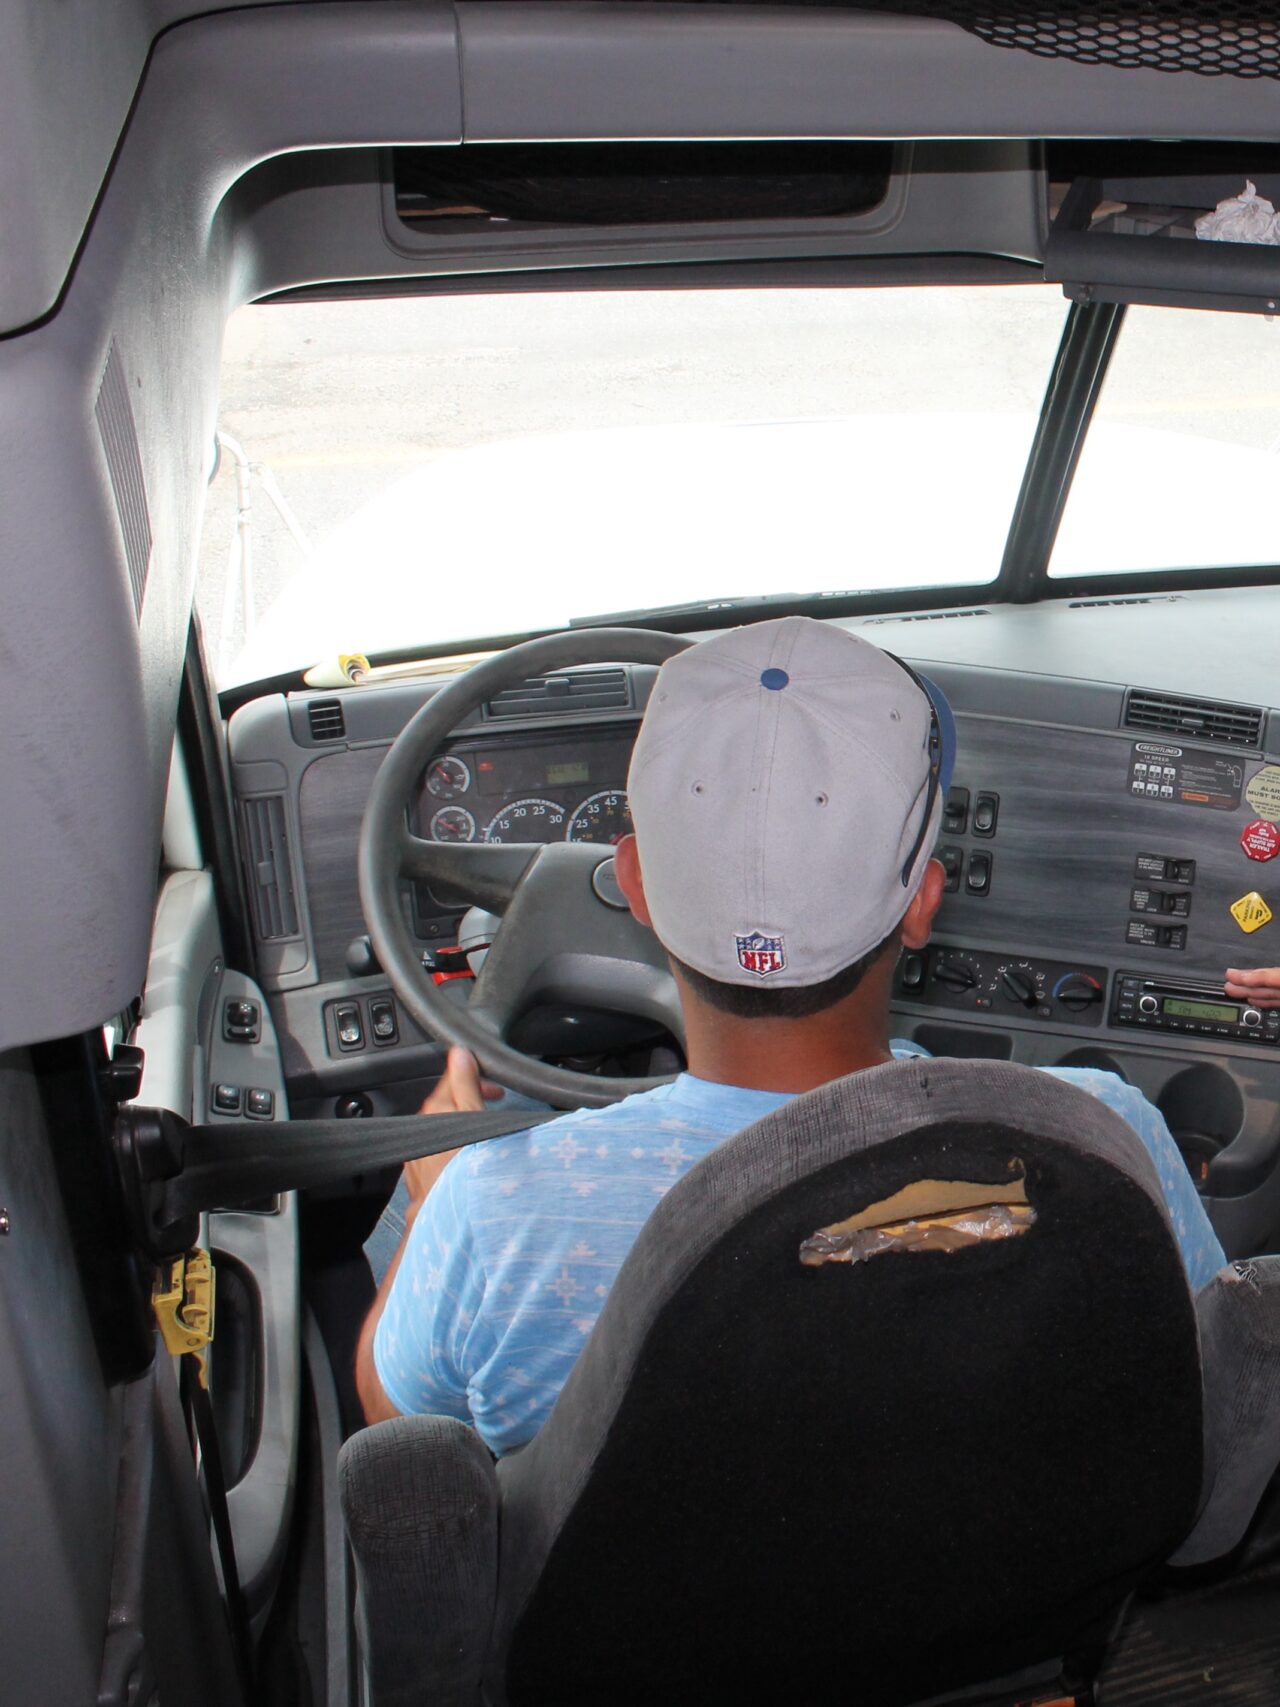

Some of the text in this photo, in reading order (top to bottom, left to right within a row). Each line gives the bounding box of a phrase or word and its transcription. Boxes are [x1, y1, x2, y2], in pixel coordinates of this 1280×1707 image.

[1139, 744, 1179, 755] FREIGHTLINER
[1247, 790, 1269, 799] MUST
[604, 796, 617, 805] 45
[513, 807, 526, 817] 20
[532, 805, 545, 815] 25
[587, 803, 599, 813] 35
[549, 814, 562, 823] 30
[575, 818, 588, 828] 25
[498, 819, 509, 829] 15
[1250, 843, 1270, 852] TRAILER
[742, 951, 781, 971] NFL
